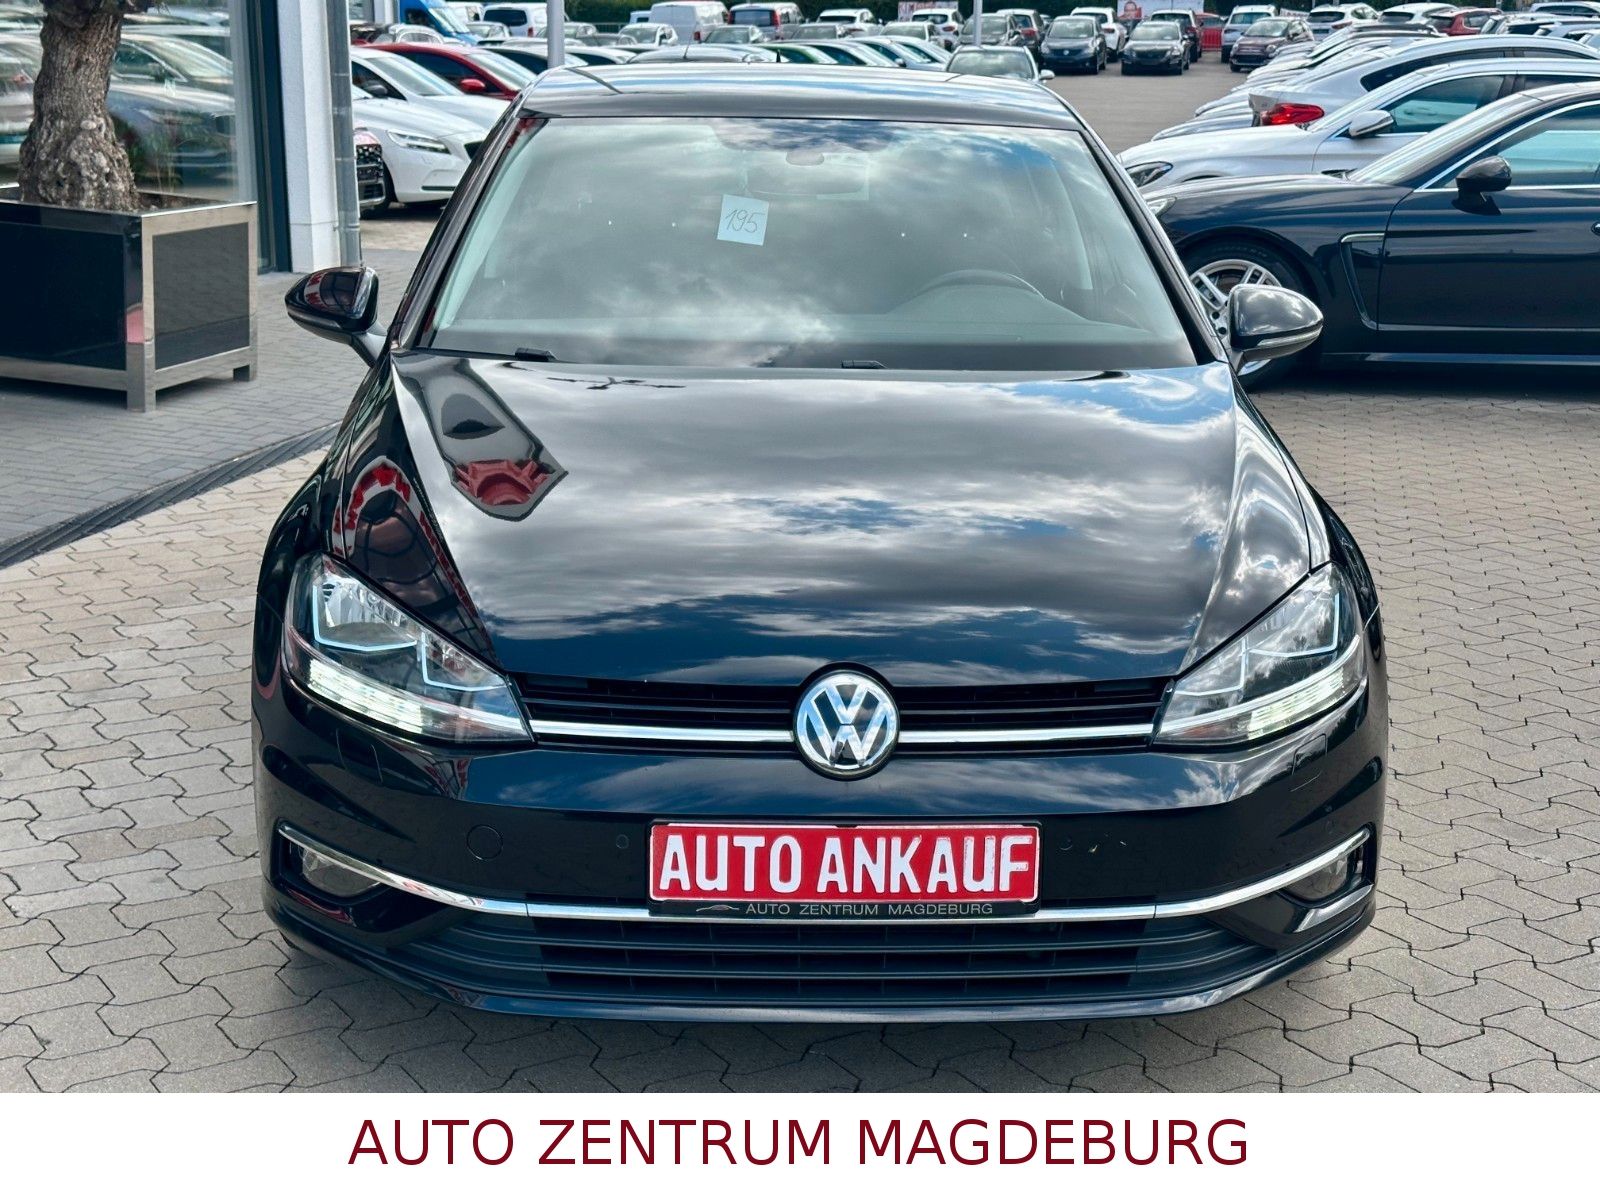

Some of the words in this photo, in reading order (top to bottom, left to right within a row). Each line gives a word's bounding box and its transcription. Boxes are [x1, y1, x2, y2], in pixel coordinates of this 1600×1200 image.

[724, 209, 766, 234] 195
[798, 674, 897, 774] VW
[658, 834, 803, 893] AUTO
[816, 835, 1034, 895] ANKAUF
[745, 903, 791, 915] AUTO
[799, 903, 879, 916] ZENTRUM
[888, 903, 993, 916] MAGDEBURG
